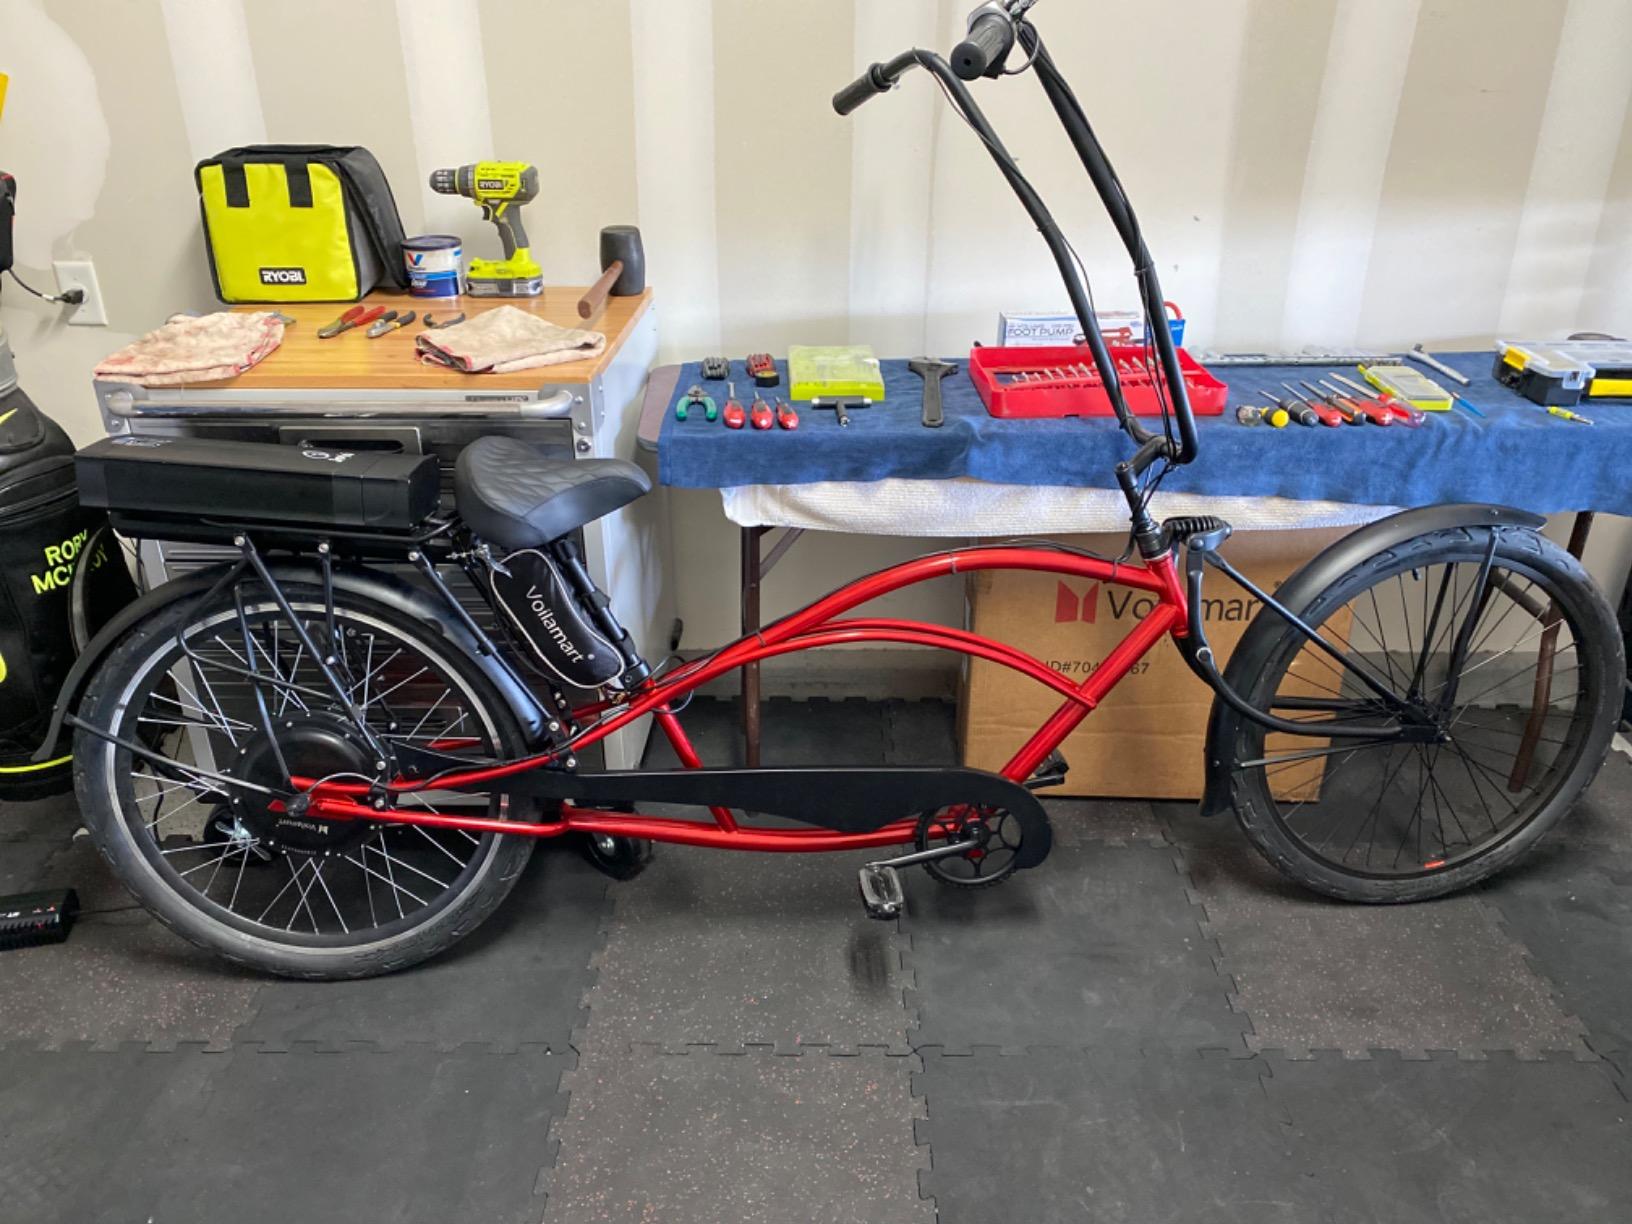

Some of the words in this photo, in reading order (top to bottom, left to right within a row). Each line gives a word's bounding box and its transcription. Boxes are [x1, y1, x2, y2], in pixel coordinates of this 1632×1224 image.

[261, 270, 306, 282] RYOBI
[1008, 328, 1037, 336] FOOT
[1040, 327, 1074, 336] PUMP
